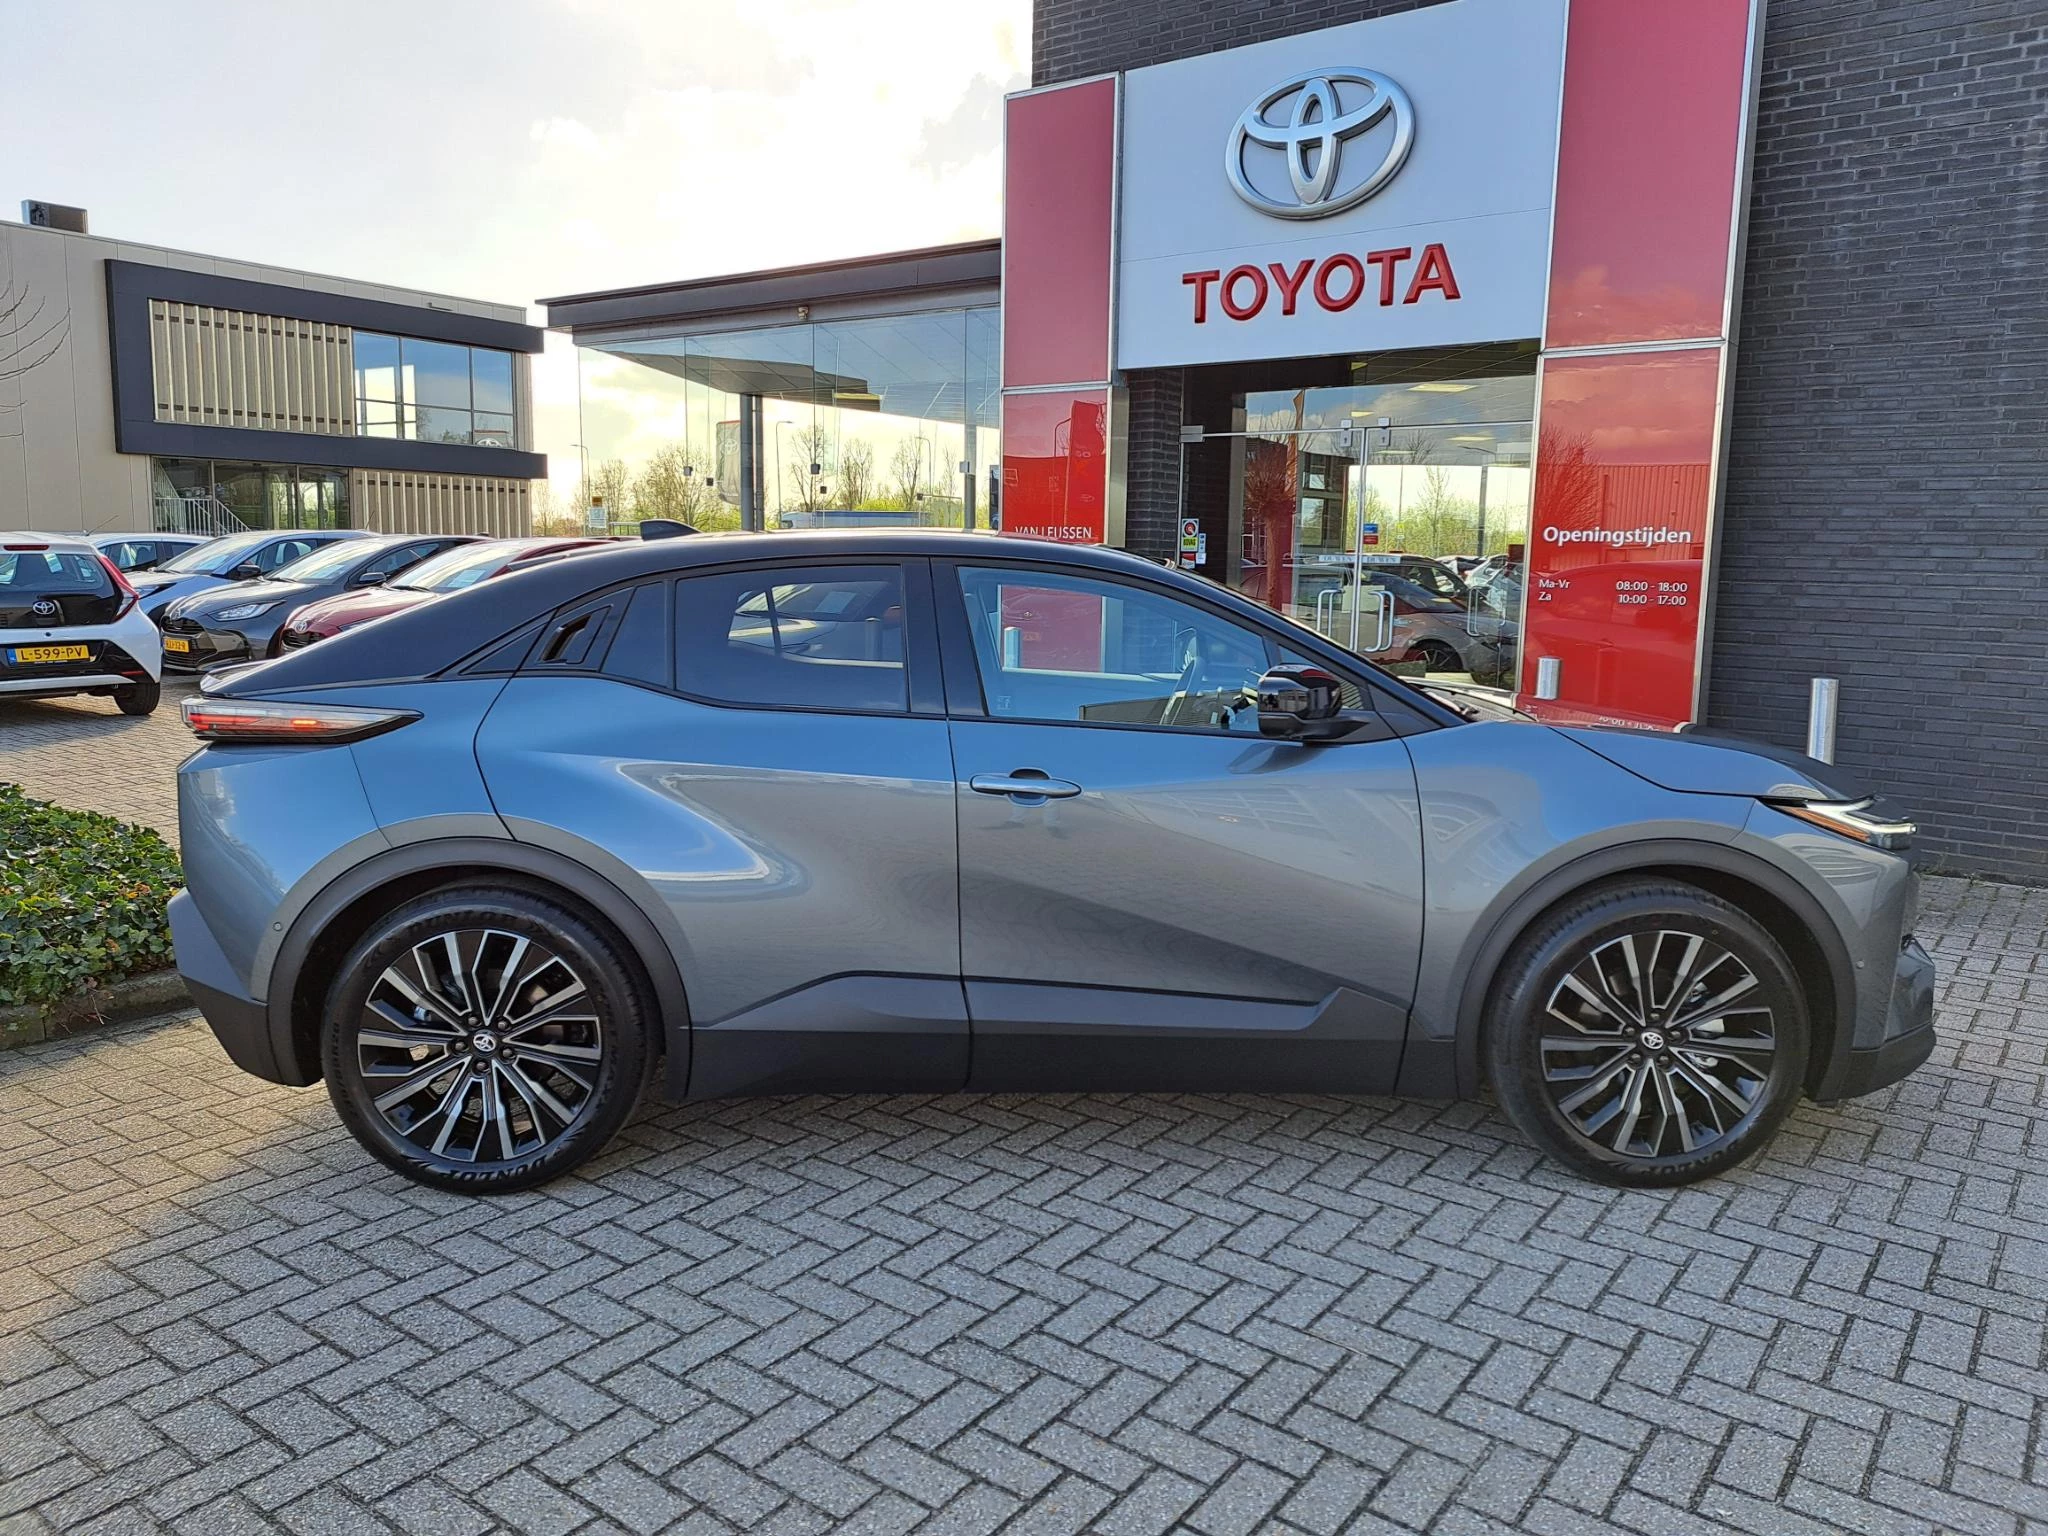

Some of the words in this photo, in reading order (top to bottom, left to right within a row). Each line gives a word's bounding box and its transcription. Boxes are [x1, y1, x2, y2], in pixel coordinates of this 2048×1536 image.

[1182, 242, 1461, 323] TOYOTA
[1543, 526, 1691, 547] Openingstijden
[1538, 579, 1570, 589] Ma-Vr
[1615, 581, 1648, 592] 08:00
[1658, 582, 1688, 593] 18:00
[1538, 591, 1552, 601] Za
[1618, 594, 1648, 604] 10:00
[1657, 595, 1687, 606] 17:00
[21, 647, 82, 660] L-599-PV
[440, 1154, 548, 1180] DUNLOP
